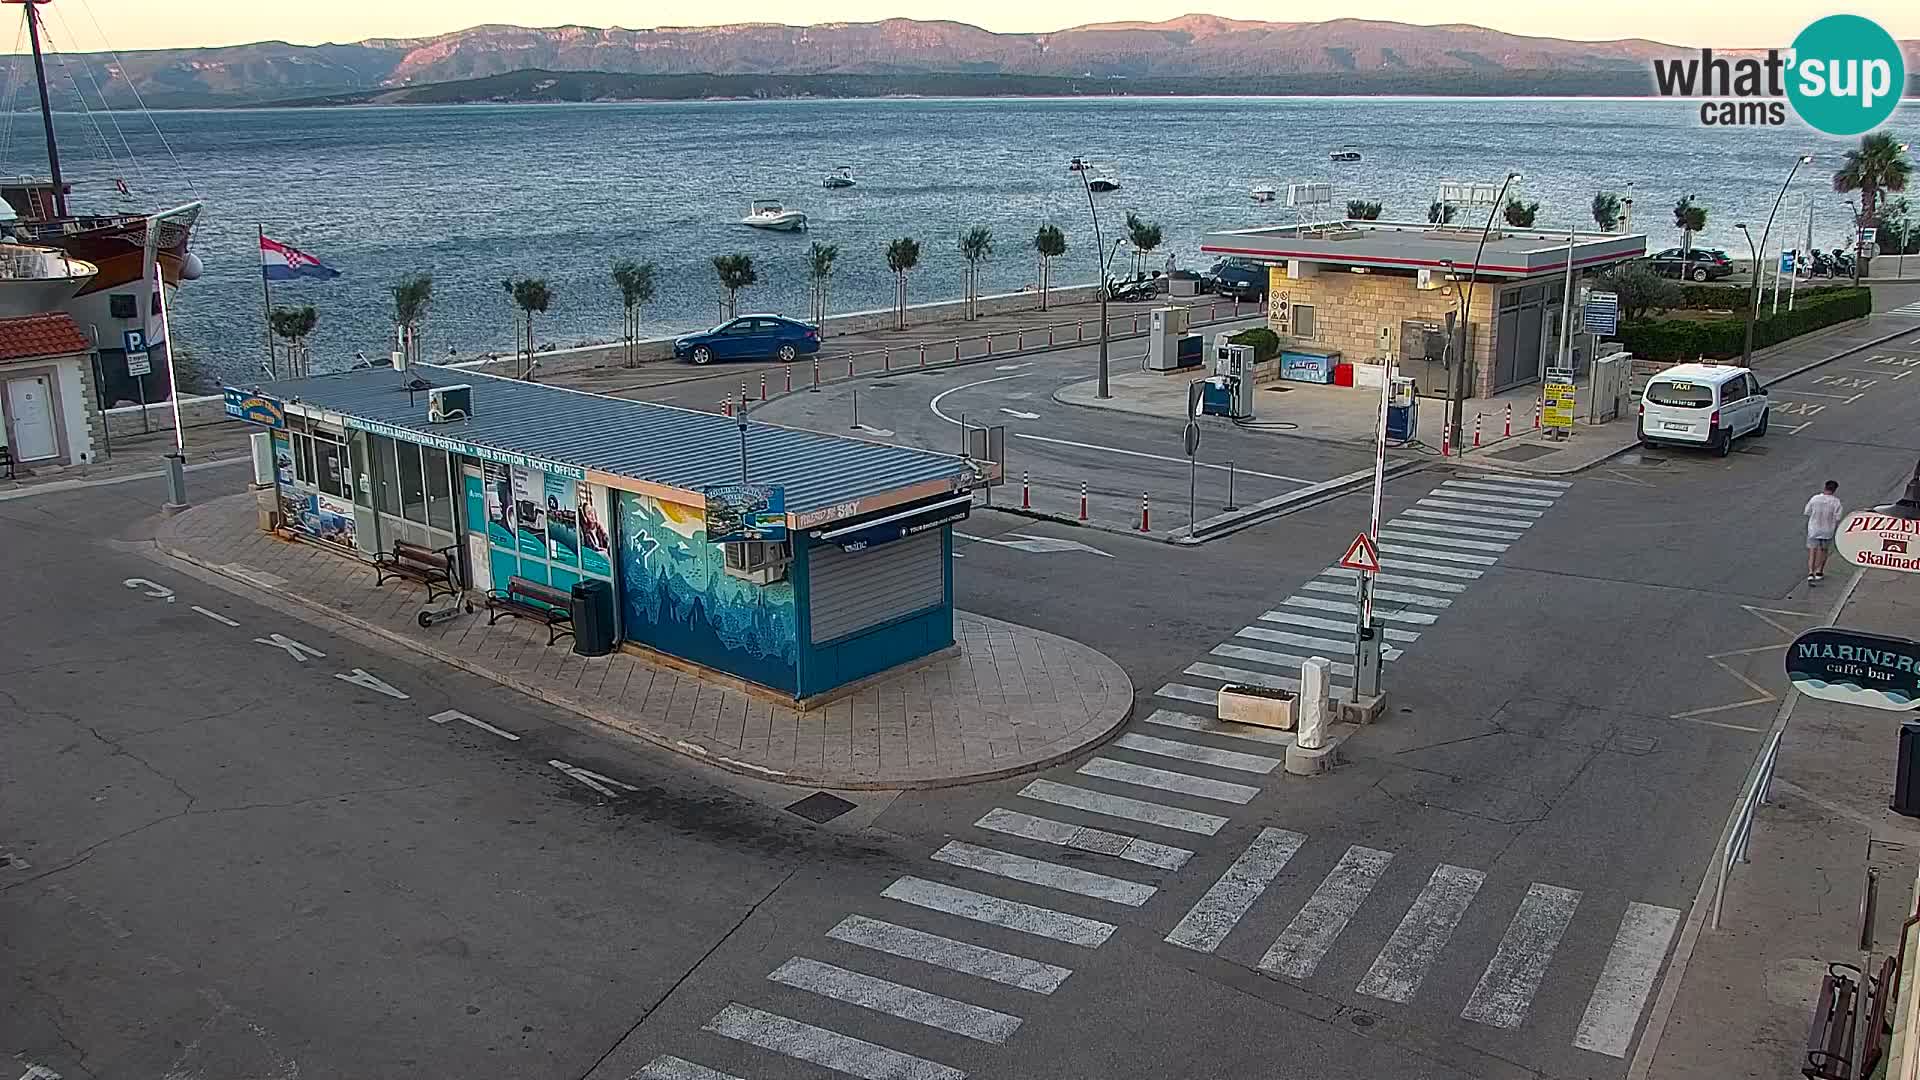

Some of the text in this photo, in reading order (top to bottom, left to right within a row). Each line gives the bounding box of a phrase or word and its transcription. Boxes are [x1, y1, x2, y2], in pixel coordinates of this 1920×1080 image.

[128, 332, 142, 351] P
[1672, 382, 1691, 391] TAXI
[1811, 376, 1878, 389] TAXI
[1768, 401, 1827, 416] AXI
[394, 426, 435, 446] AUTOBUSNA
[435, 436, 467, 453] POSTAJA
[476, 447, 492, 459] BUS
[492, 450, 525, 467] STATION
[526, 457, 553, 473] TICKET
[553, 466, 582, 480] OFFICE
[1879, 532, 1912, 541] GRILL
[1826, 663, 1895, 680] caffe bar
